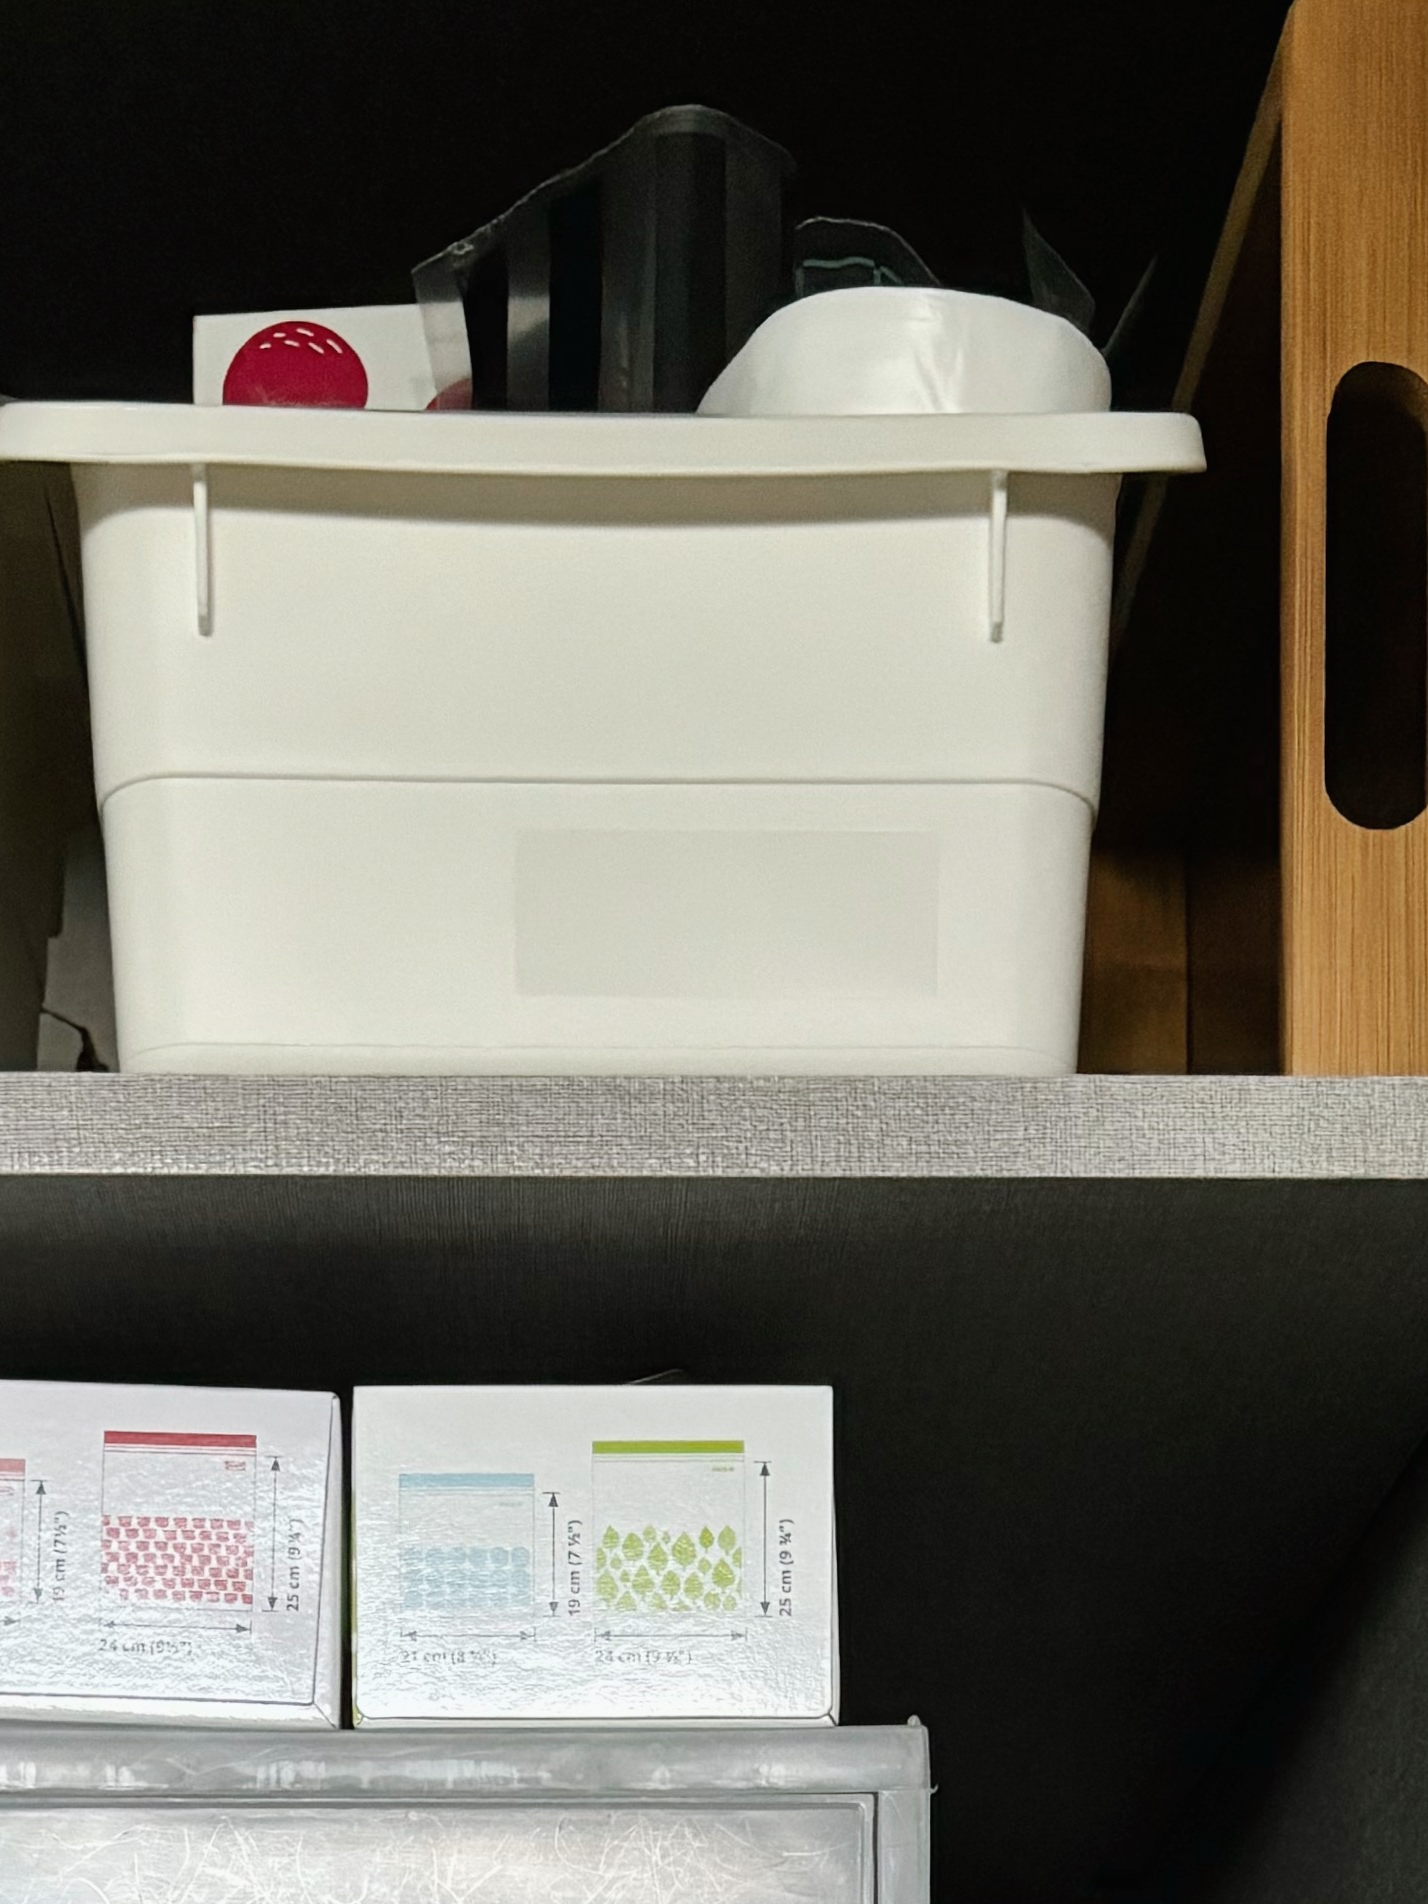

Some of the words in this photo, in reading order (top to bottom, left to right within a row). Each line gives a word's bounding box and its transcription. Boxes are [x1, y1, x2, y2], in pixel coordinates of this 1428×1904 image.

[54, 1561, 66, 1582] cm
[288, 1566, 300, 1590] cm
[570, 1570, 581, 1594] cm
[780, 1569, 792, 1594] cm
[286, 1594, 300, 1612] 25
[568, 1599, 581, 1617] 19
[779, 1600, 792, 1617] 25
